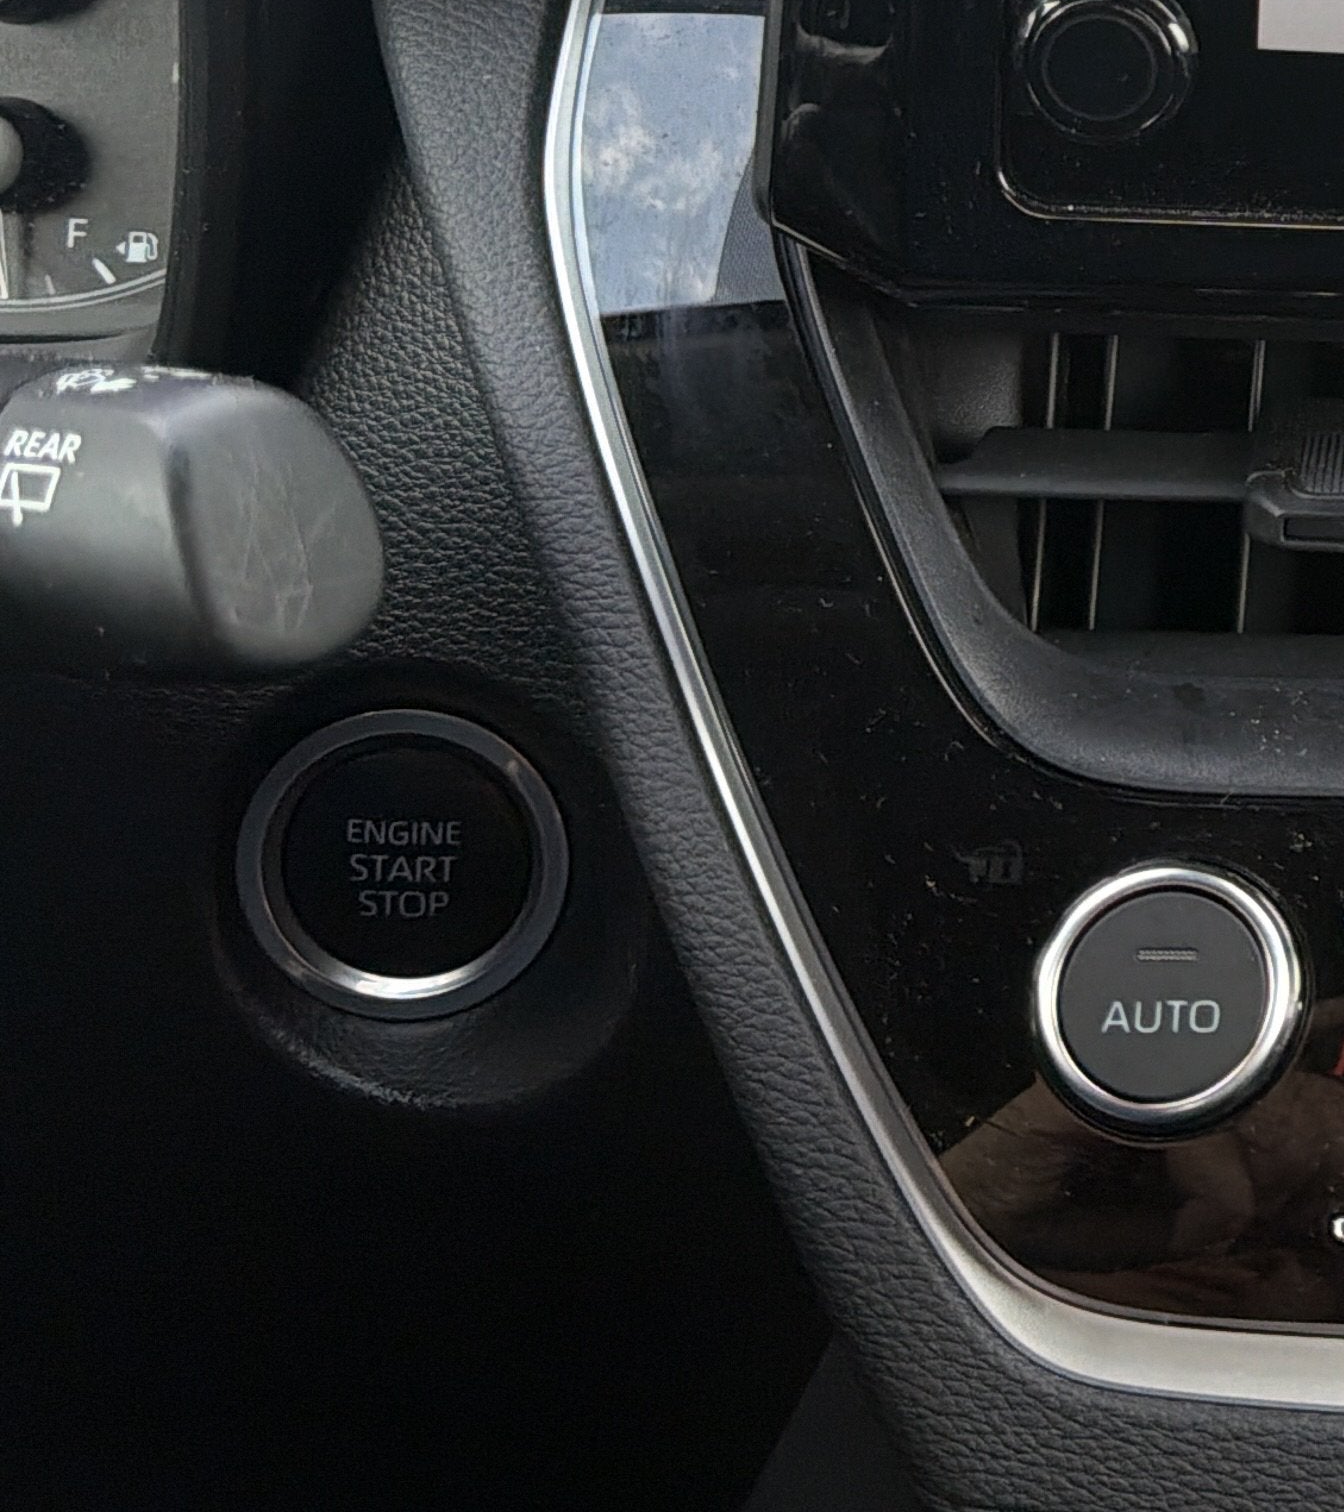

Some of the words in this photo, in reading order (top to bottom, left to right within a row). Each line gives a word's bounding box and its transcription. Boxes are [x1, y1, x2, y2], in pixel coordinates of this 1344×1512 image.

[67, 218, 88, 248] F
[4, 430, 81, 463] REAR
[347, 818, 462, 846] ENGINE
[350, 853, 458, 882] START
[358, 890, 449, 917] STOP
[1101, 1000, 1221, 1033] AUTO
